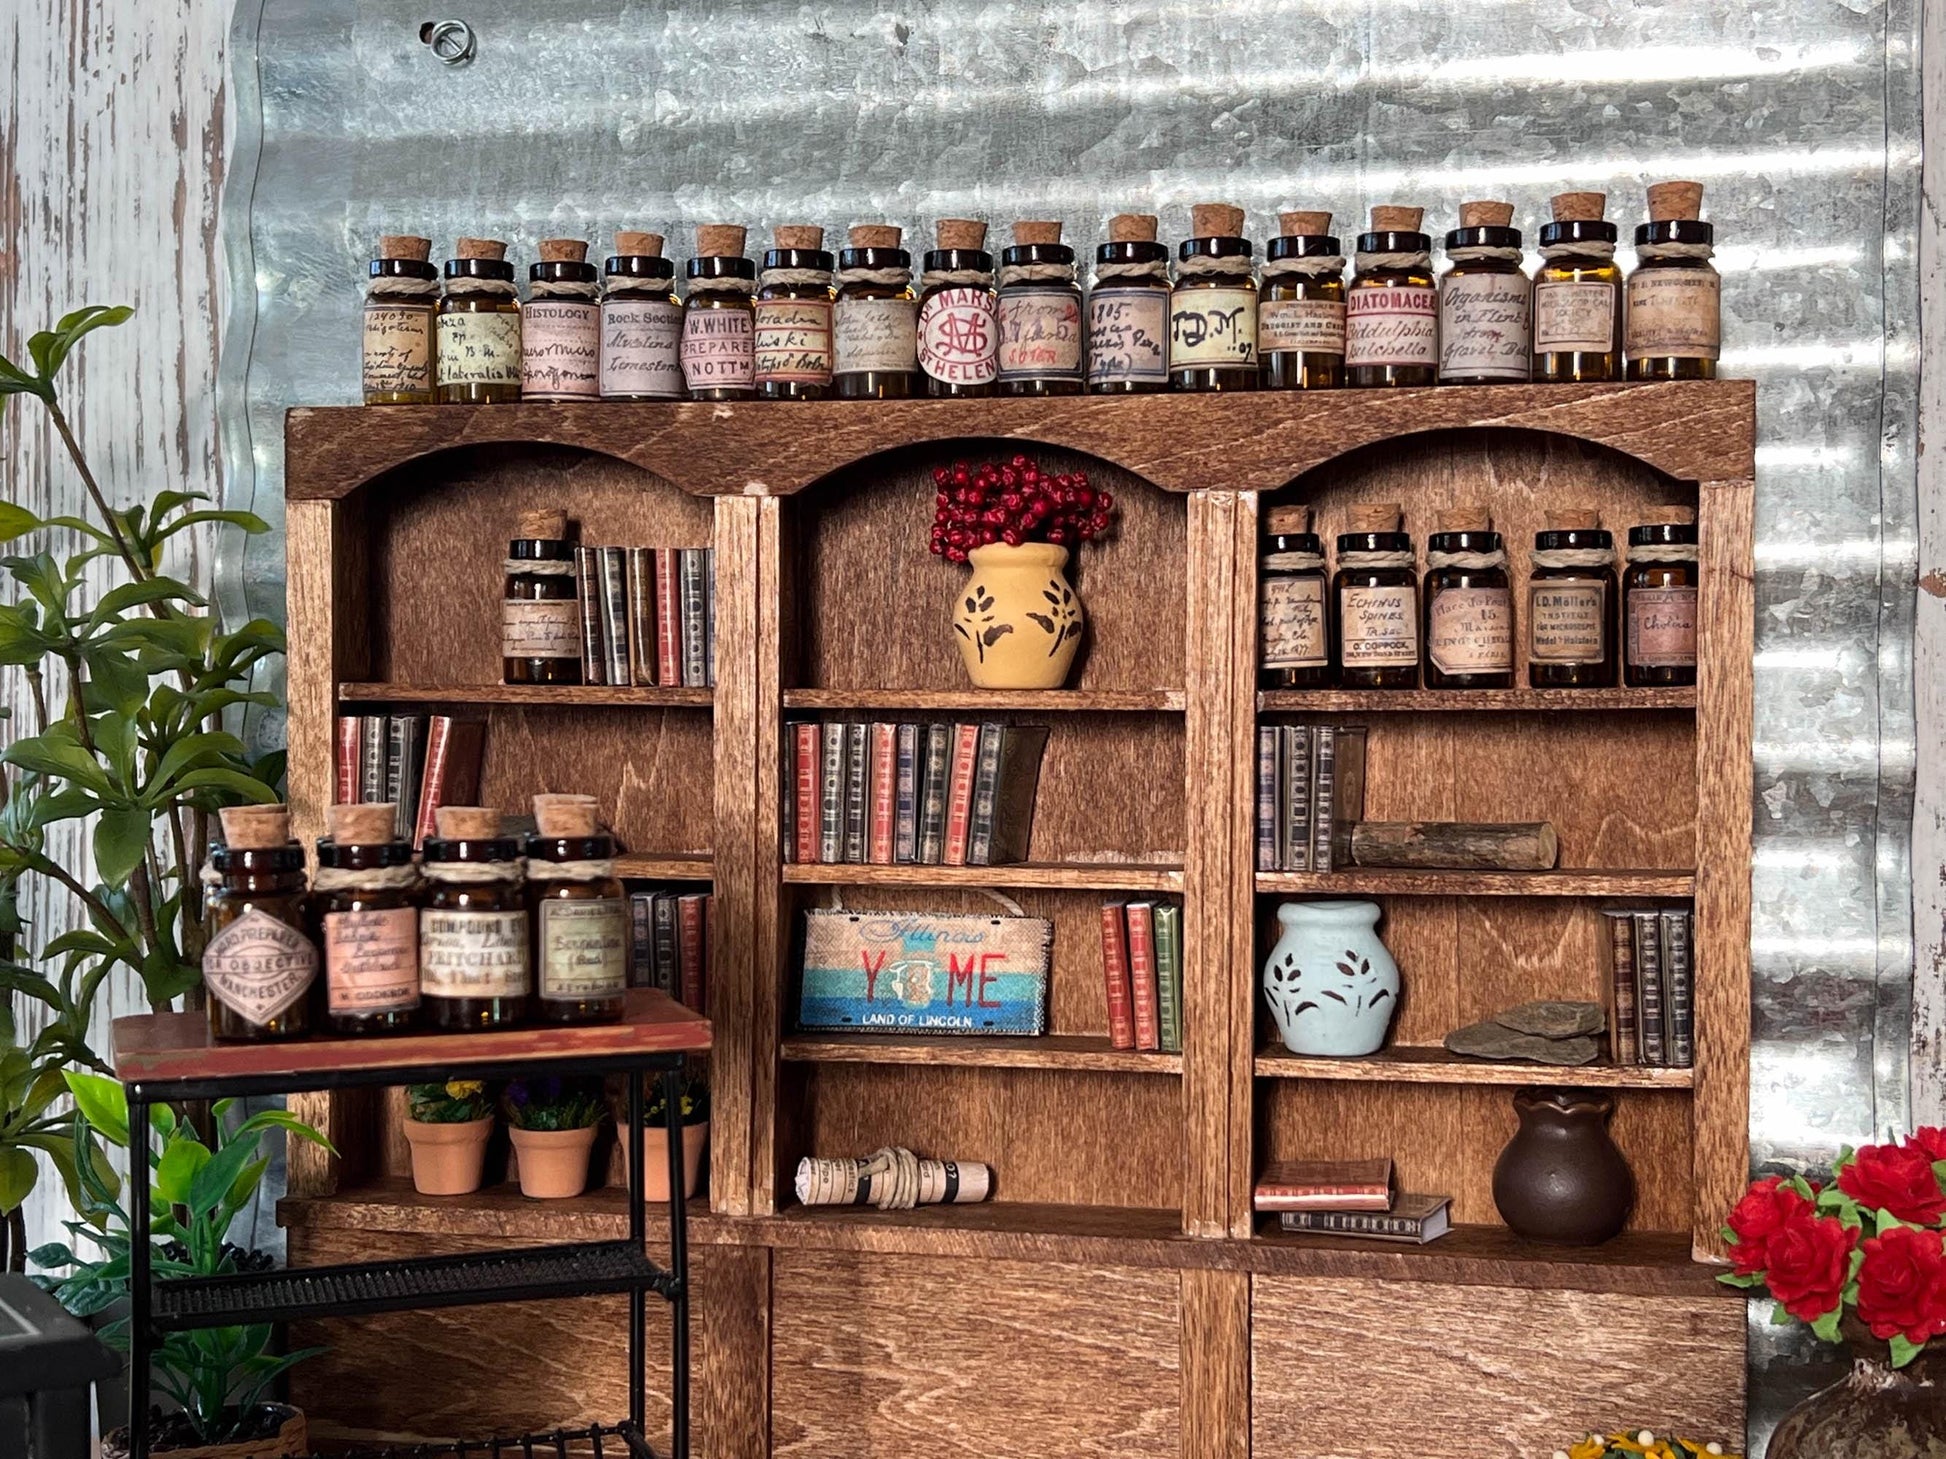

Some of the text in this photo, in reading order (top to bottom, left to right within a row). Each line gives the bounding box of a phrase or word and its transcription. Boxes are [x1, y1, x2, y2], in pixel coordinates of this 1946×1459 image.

[938, 287, 998, 317] MARS
[608, 313, 640, 325] Rock
[934, 356, 997, 380] HELEN
[862, 1013, 973, 1028] LAND OF LINCOLN
